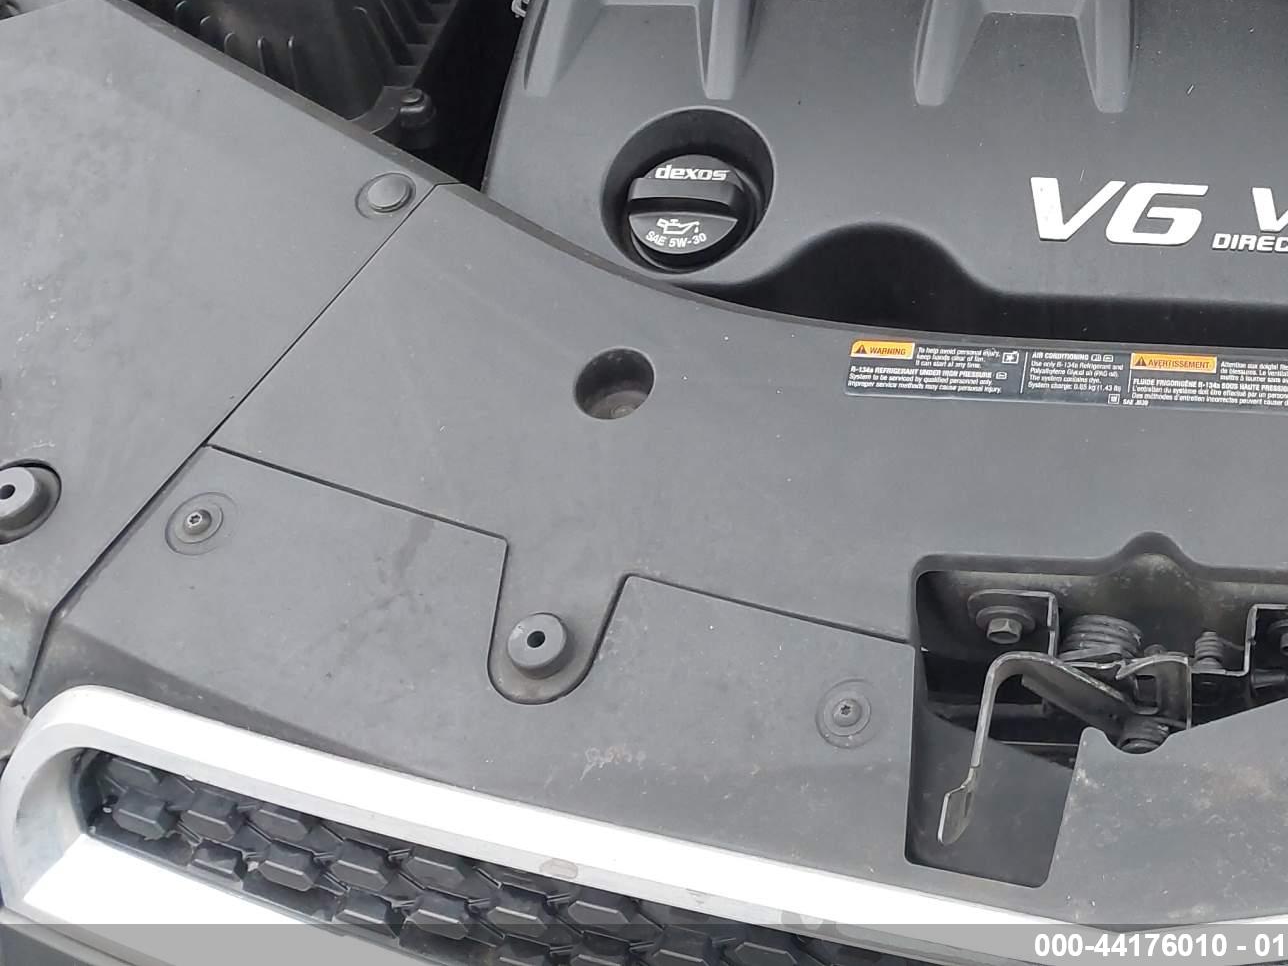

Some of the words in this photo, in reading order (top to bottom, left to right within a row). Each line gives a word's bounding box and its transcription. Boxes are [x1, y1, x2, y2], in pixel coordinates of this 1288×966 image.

[654, 164, 731, 181] dexos
[1030, 176, 1209, 247] V6
[645, 230, 667, 246] SAE
[668, 232, 707, 248] 5W-30
[870, 347, 906, 355] WARNING
[926, 347, 939, 356] help
[957, 348, 982, 357] personal
[1044, 352, 1089, 361] CONDITIONING
[1043, 361, 1056, 369] only
[1079, 362, 1111, 371] Refrigerant
[1148, 359, 1209, 369] AVERTISSEMENT
[850, 366, 874, 374] R-134a
[874, 367, 919, 375] REFRIGERANT
[849, 373, 872, 381] System
[924, 376, 949, 384] qualified
[950, 377, 979, 386] personnel
[1041, 375, 1062, 383] system
[957, 385, 983, 393] personal
[1028, 381, 1050, 390] System
[1133, 378, 1156, 386] FLUIDE
[1198, 381, 1220, 389] R-134a
[1221, 382, 1238, 390] SOUS
[1240, 383, 1260, 391] HAUTE
[1206, 396, 1238, 404] incorrectes
[1239, 398, 1263, 406] peuvent
